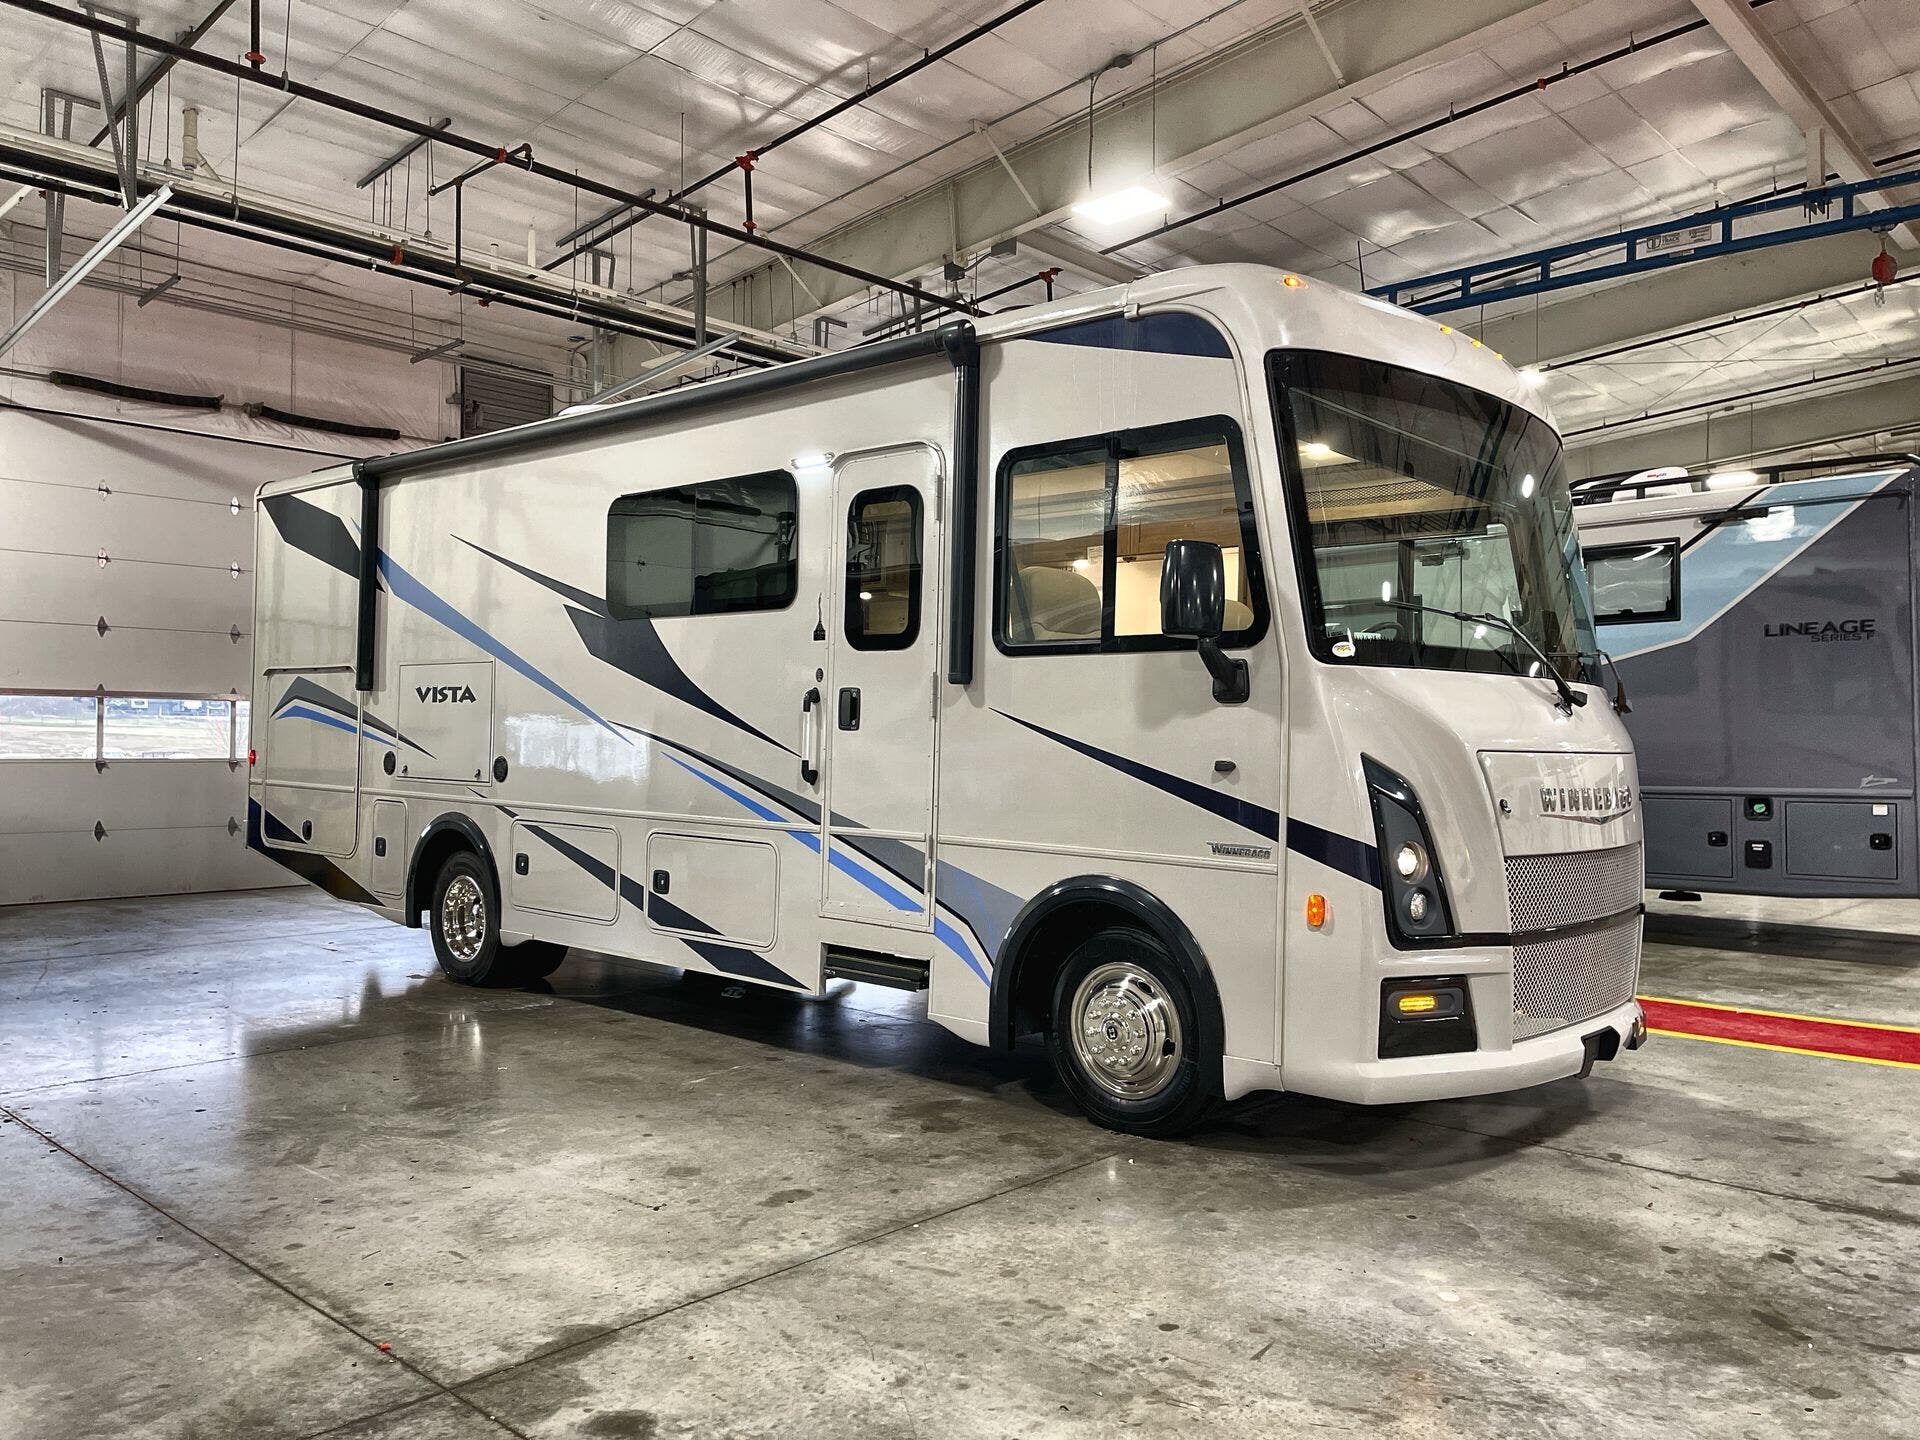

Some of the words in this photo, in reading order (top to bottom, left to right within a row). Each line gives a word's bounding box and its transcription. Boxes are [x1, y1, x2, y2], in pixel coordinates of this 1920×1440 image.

[1764, 619, 1876, 637] LINEAGE
[1811, 632, 1861, 642] SERIES
[1866, 632, 1875, 640] F
[415, 684, 477, 703] VISTA
